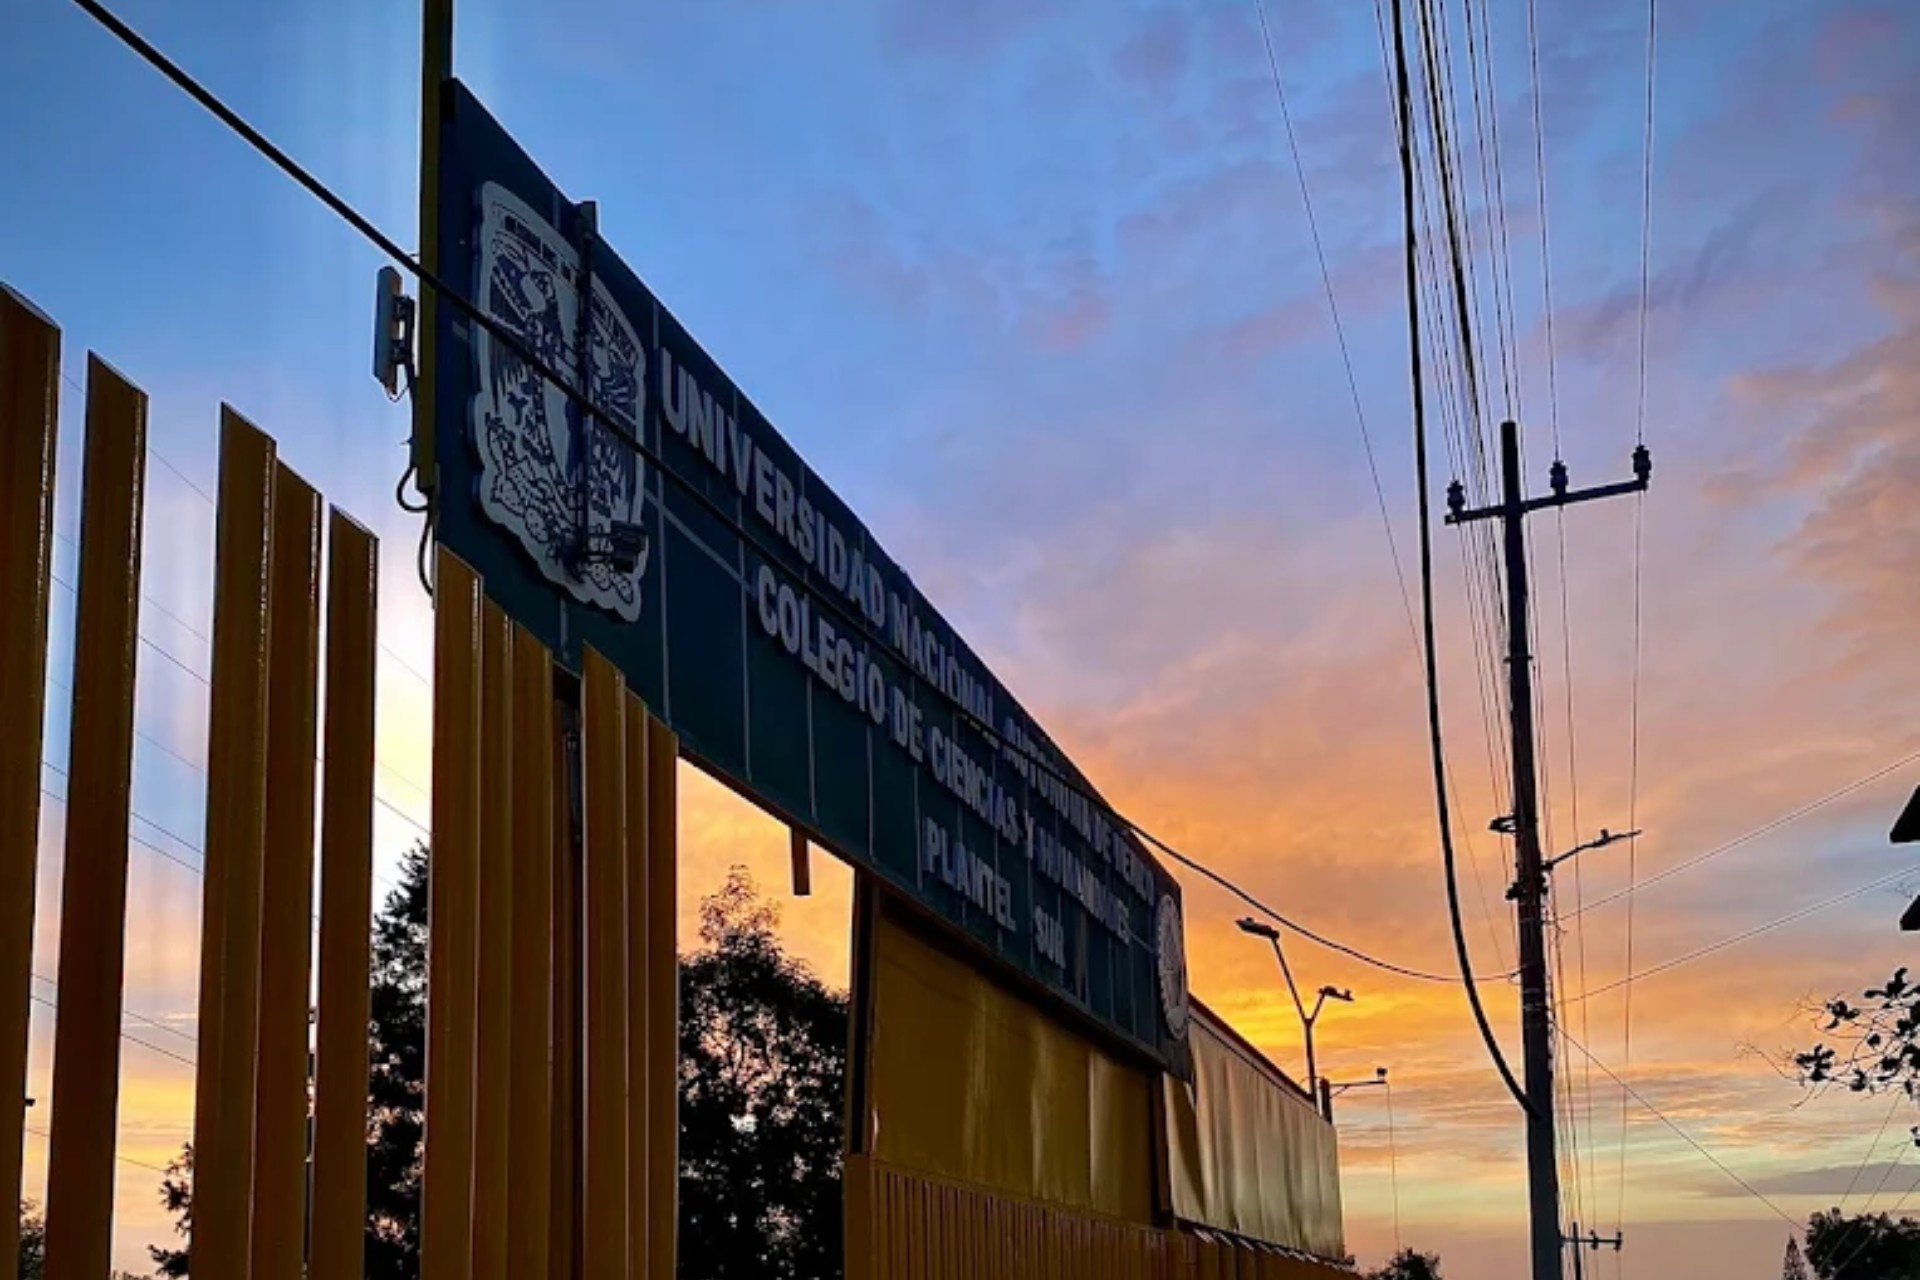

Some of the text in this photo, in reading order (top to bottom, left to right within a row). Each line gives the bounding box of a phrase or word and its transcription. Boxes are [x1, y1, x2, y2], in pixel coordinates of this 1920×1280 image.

[661, 345, 886, 630] UNIVERSIDAD
[887, 589, 1001, 748] NACIONAL
[757, 564, 886, 725] COLEGIO
[889, 685, 924, 762] DE
[929, 726, 1021, 846] CIENCIAS
[1023, 808, 1035, 860] Y
[923, 816, 1067, 970] PLANTEL SUR
